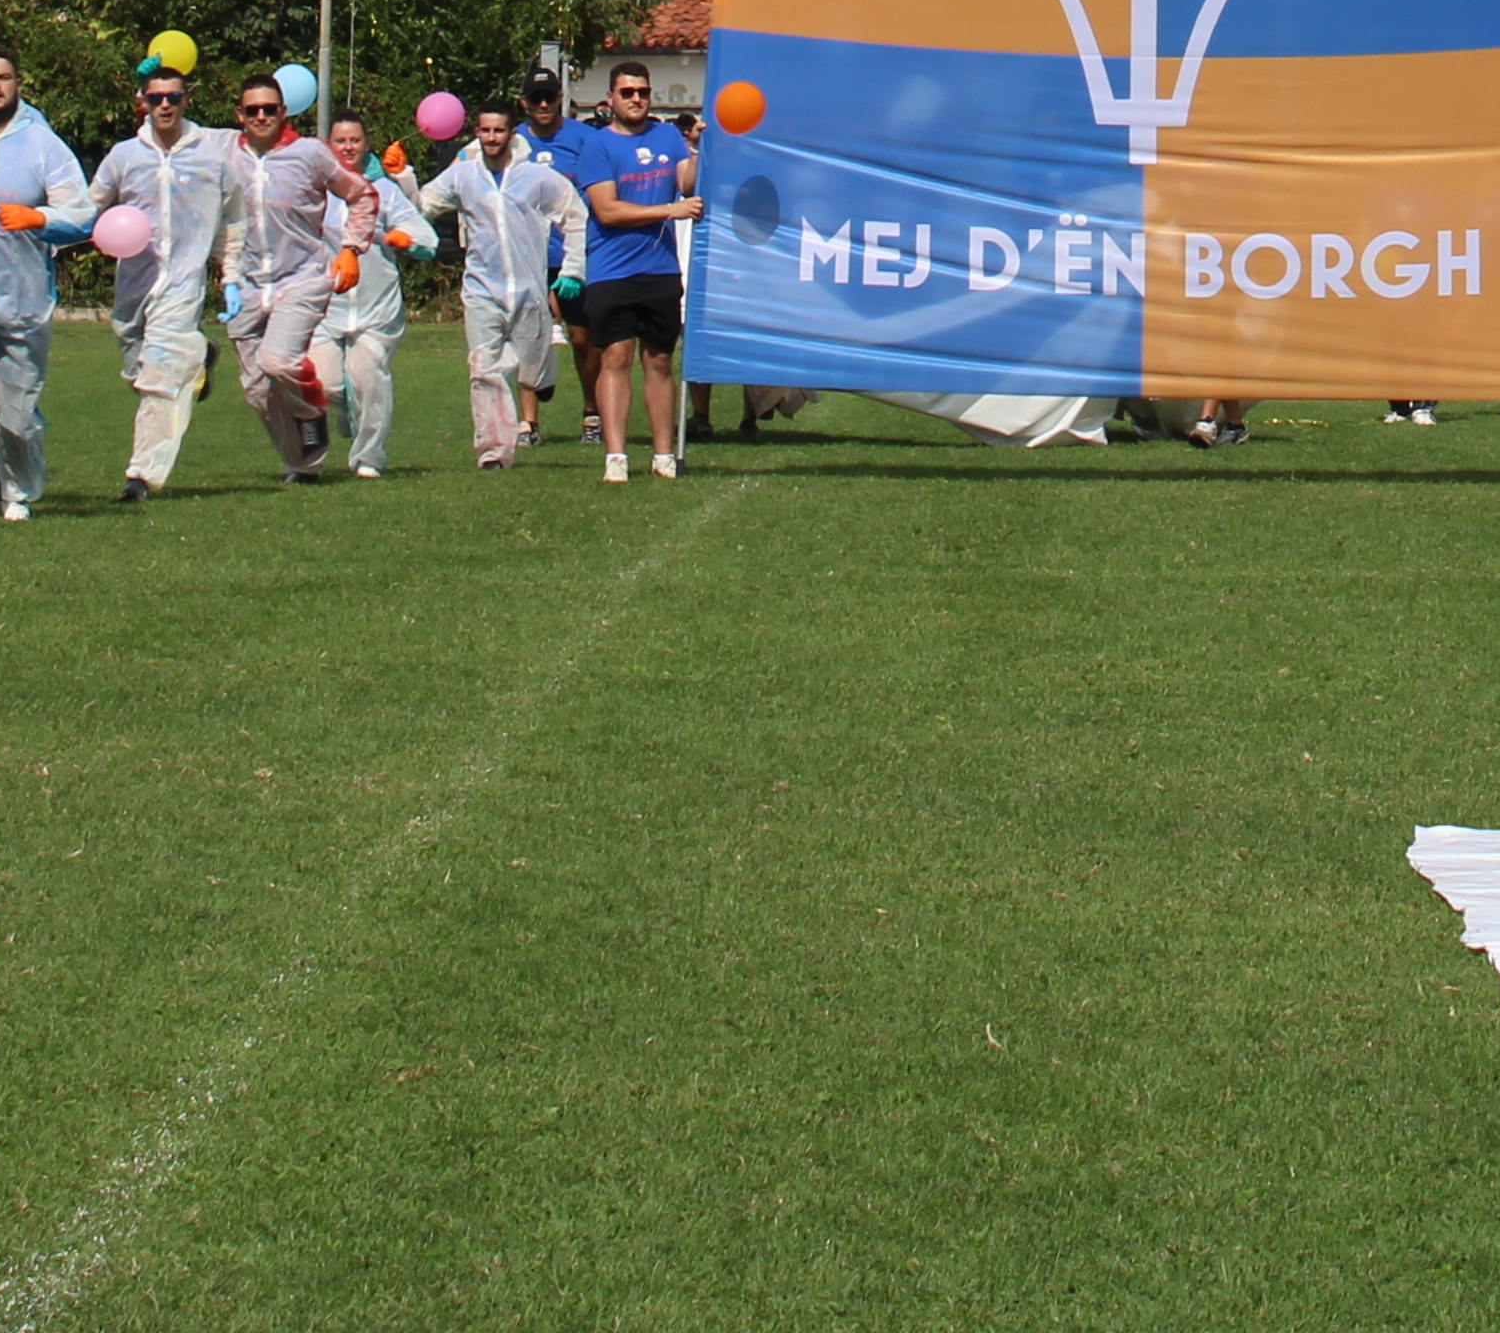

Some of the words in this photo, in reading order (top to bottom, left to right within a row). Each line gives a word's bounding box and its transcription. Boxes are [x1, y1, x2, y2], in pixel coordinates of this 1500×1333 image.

[799, 215, 931, 288] MEJ
[969, 213, 1146, 298] D'ËN
[1185, 229, 1481, 299] BORGH
